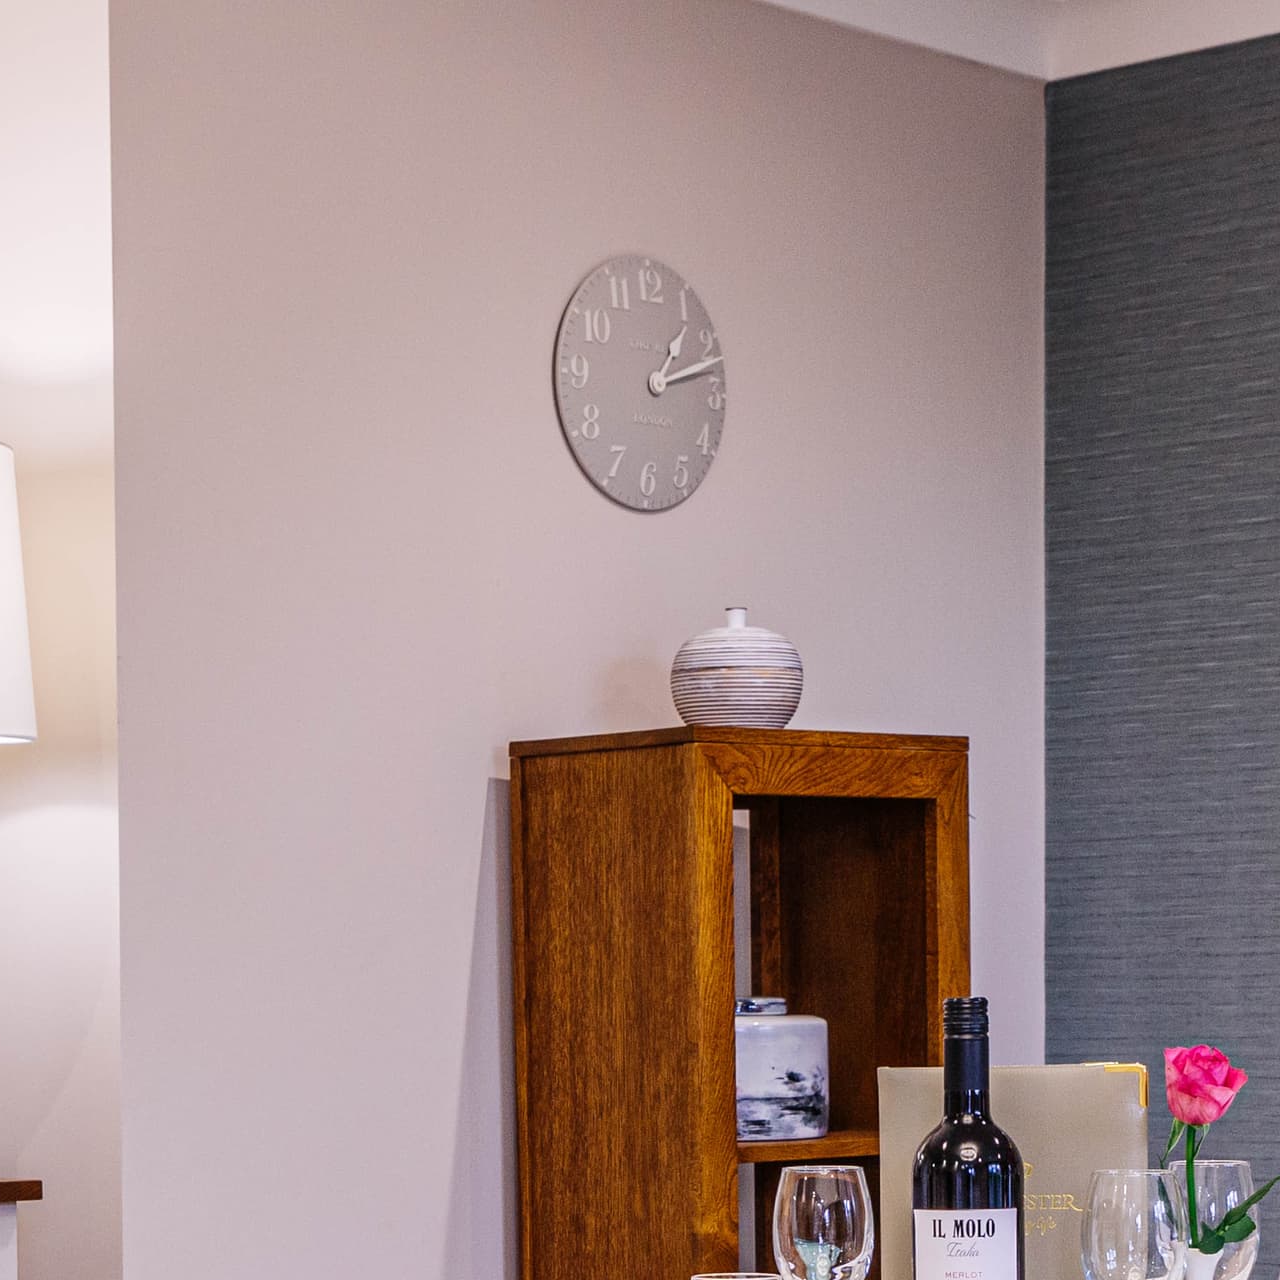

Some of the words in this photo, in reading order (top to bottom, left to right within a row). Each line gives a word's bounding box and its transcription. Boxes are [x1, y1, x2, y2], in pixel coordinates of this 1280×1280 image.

[609, 276, 630, 310] 11
[638, 269, 664, 304] 12
[679, 289, 688, 322] 1
[584, 307, 611, 344] 10
[699, 329, 715, 360] 2
[571, 353, 589, 388] 9
[708, 376, 721, 410] 3
[582, 404, 600, 439] 8
[696, 422, 709, 455] 4
[609, 445, 627, 477] 7
[673, 455, 689, 489] 5
[639, 462, 657, 497] 6
[1024, 1194, 1083, 1212] STER
[932, 1219, 946, 1239] IL
[952, 1218, 996, 1239] MOLO
[944, 1271, 984, 1279] MERLOT
